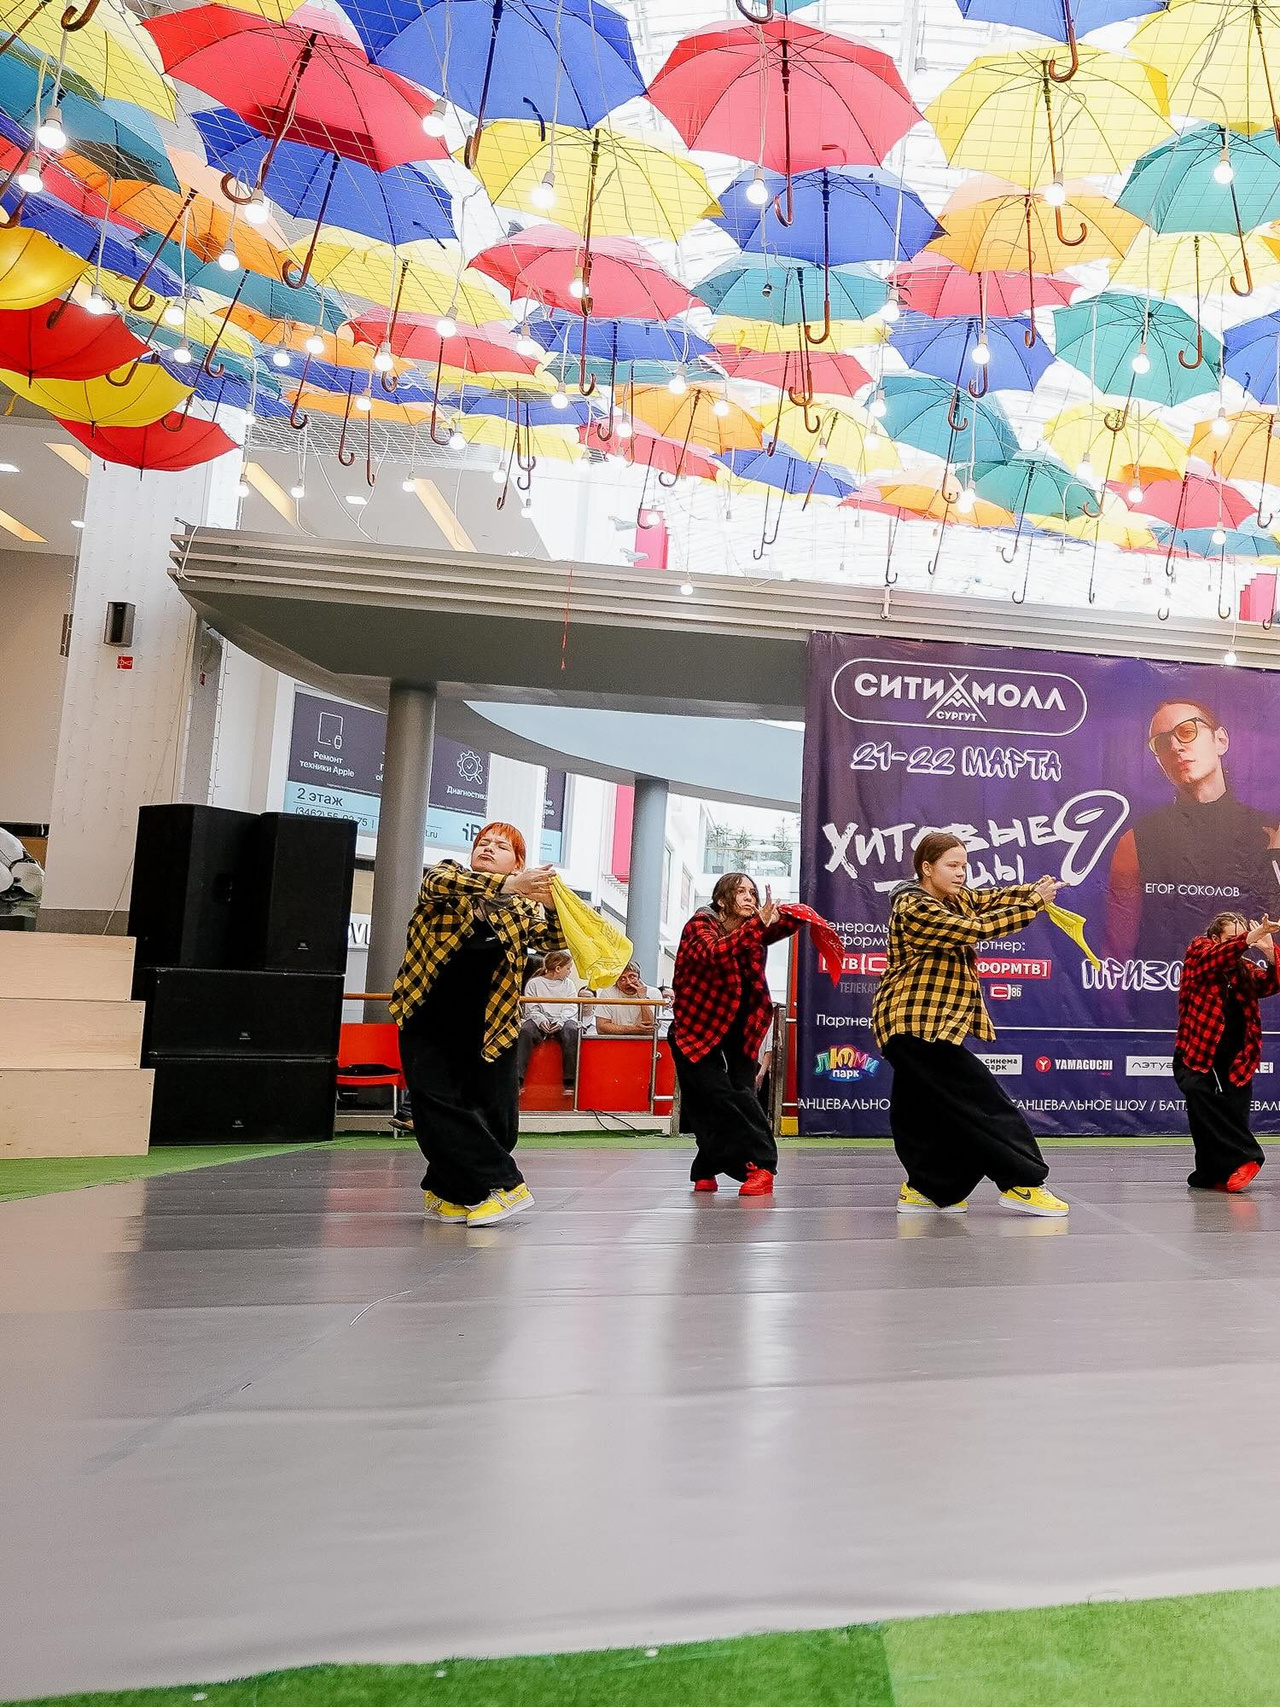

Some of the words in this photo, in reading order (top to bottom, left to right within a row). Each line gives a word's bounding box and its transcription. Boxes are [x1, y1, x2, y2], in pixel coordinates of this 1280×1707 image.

[936, 711, 978, 722] СУРГУТ
[313, 751, 343, 764] Ремонт
[850, 741, 956, 776] 21-22
[962, 746, 1062, 782] МАРТА
[300, 760, 332, 773] техники
[333, 766, 355, 778] Apple
[297, 787, 306, 800] 2
[309, 792, 343, 807] этаж
[1145, 883, 1174, 895] ЕГОР
[1178, 884, 1241, 898] СОКОЛОВ
[1055, 1059, 1113, 1071] YAMAGUCHI
[832, 1069, 860, 1079] парк
[798, 1097, 891, 1111] АНЦЕВАЛЬНО
[1115, 1100, 1148, 1112] ШОУ
